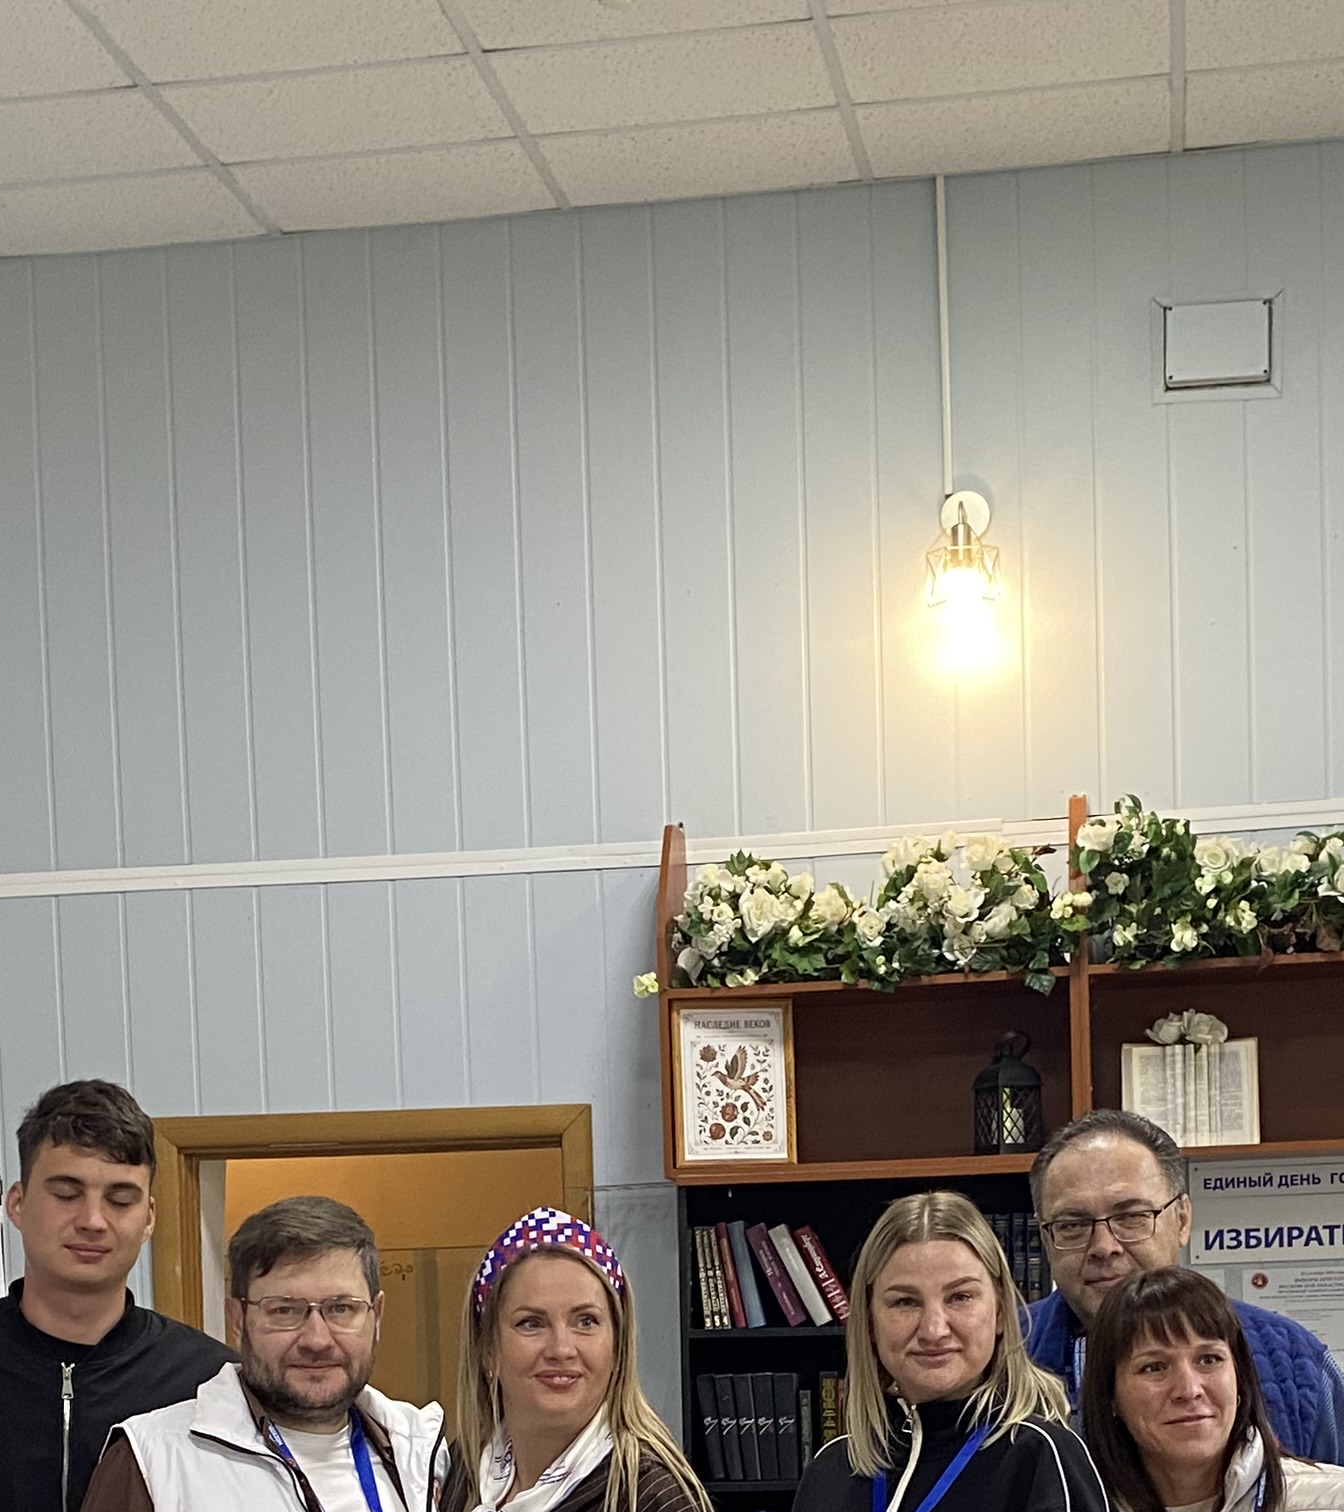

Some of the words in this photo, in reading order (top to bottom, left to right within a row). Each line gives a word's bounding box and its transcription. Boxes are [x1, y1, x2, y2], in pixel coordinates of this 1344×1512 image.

[694, 1020, 741, 1030] НАСЛЕДИЕ
[744, 1019, 771, 1029] ВЕКОВ
[1203, 1173, 1273, 1190] ЕДИНЫЙ
[1277, 1173, 1321, 1189] ДЕНЬ
